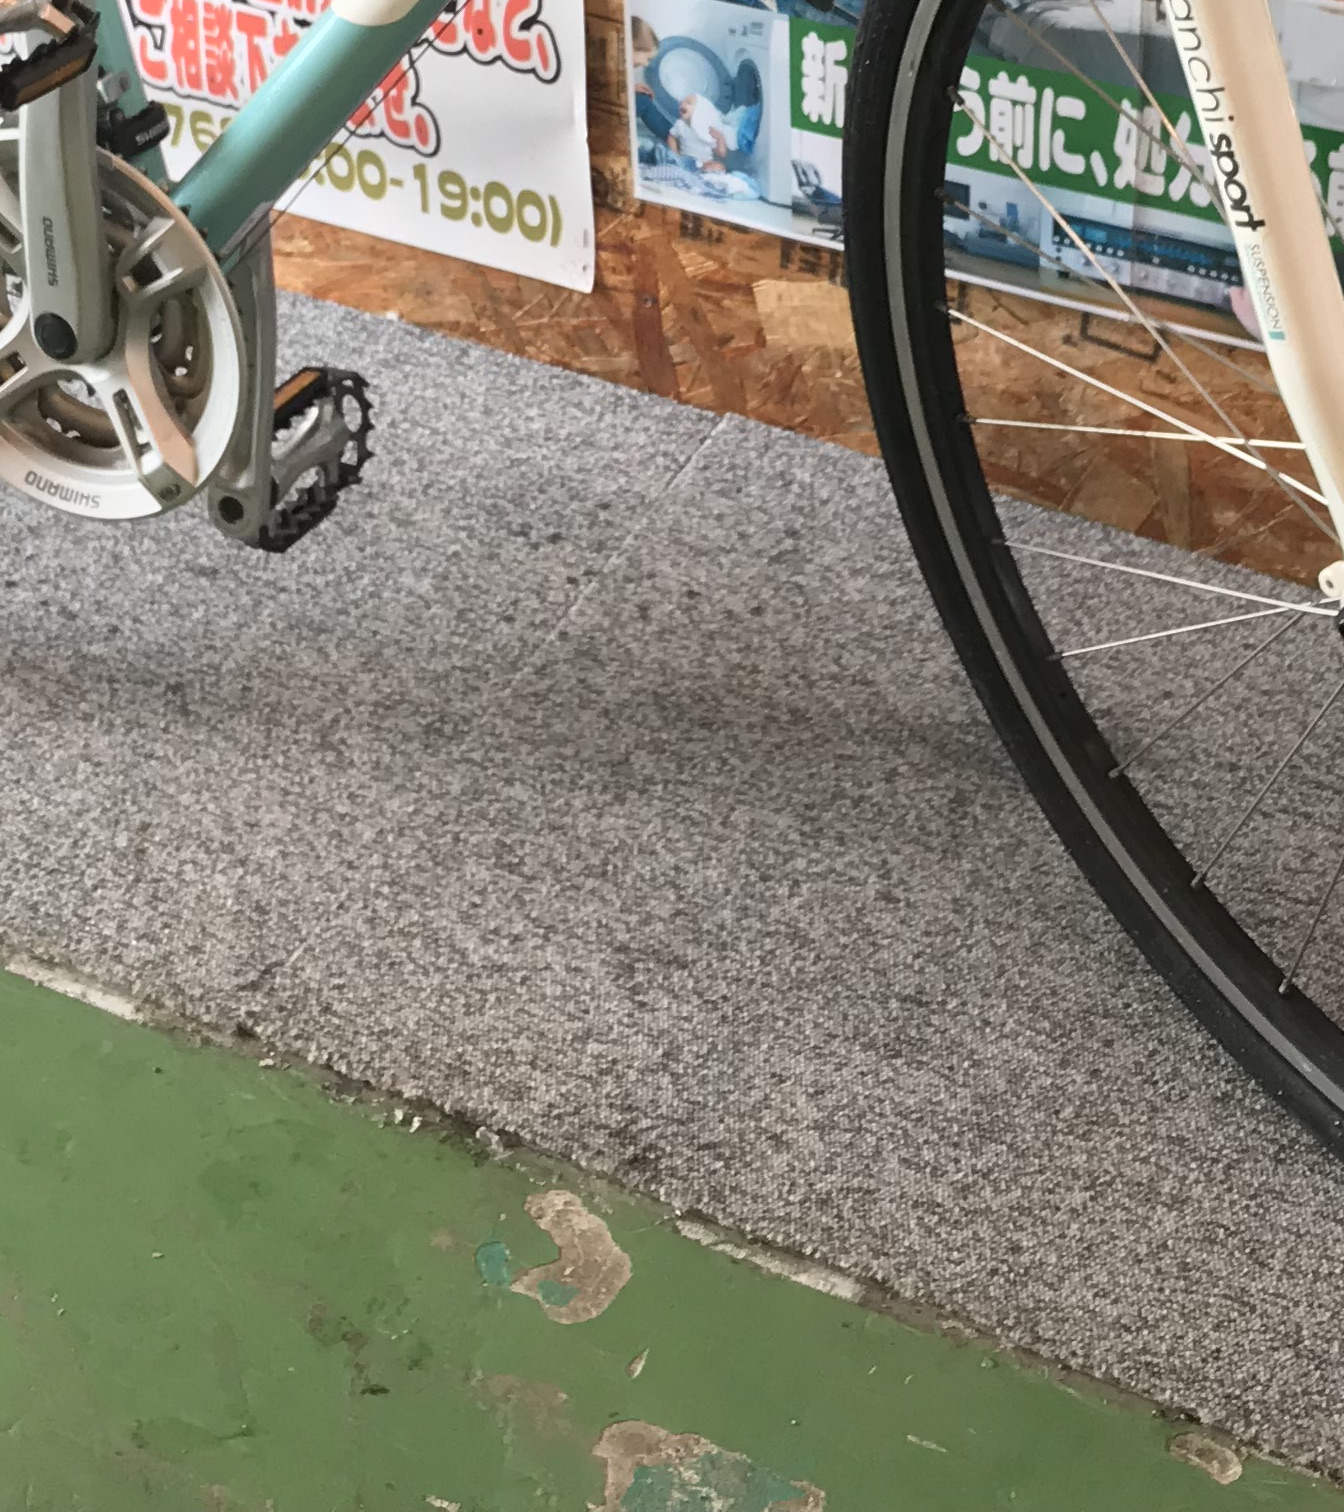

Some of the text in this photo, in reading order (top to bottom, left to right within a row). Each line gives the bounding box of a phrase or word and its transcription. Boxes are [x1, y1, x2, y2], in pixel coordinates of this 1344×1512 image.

[42, 216, 59, 288] SHIMANO
[1248, 243, 1283, 331] SUSPENSION
[24, 469, 102, 510] SHIMANO
